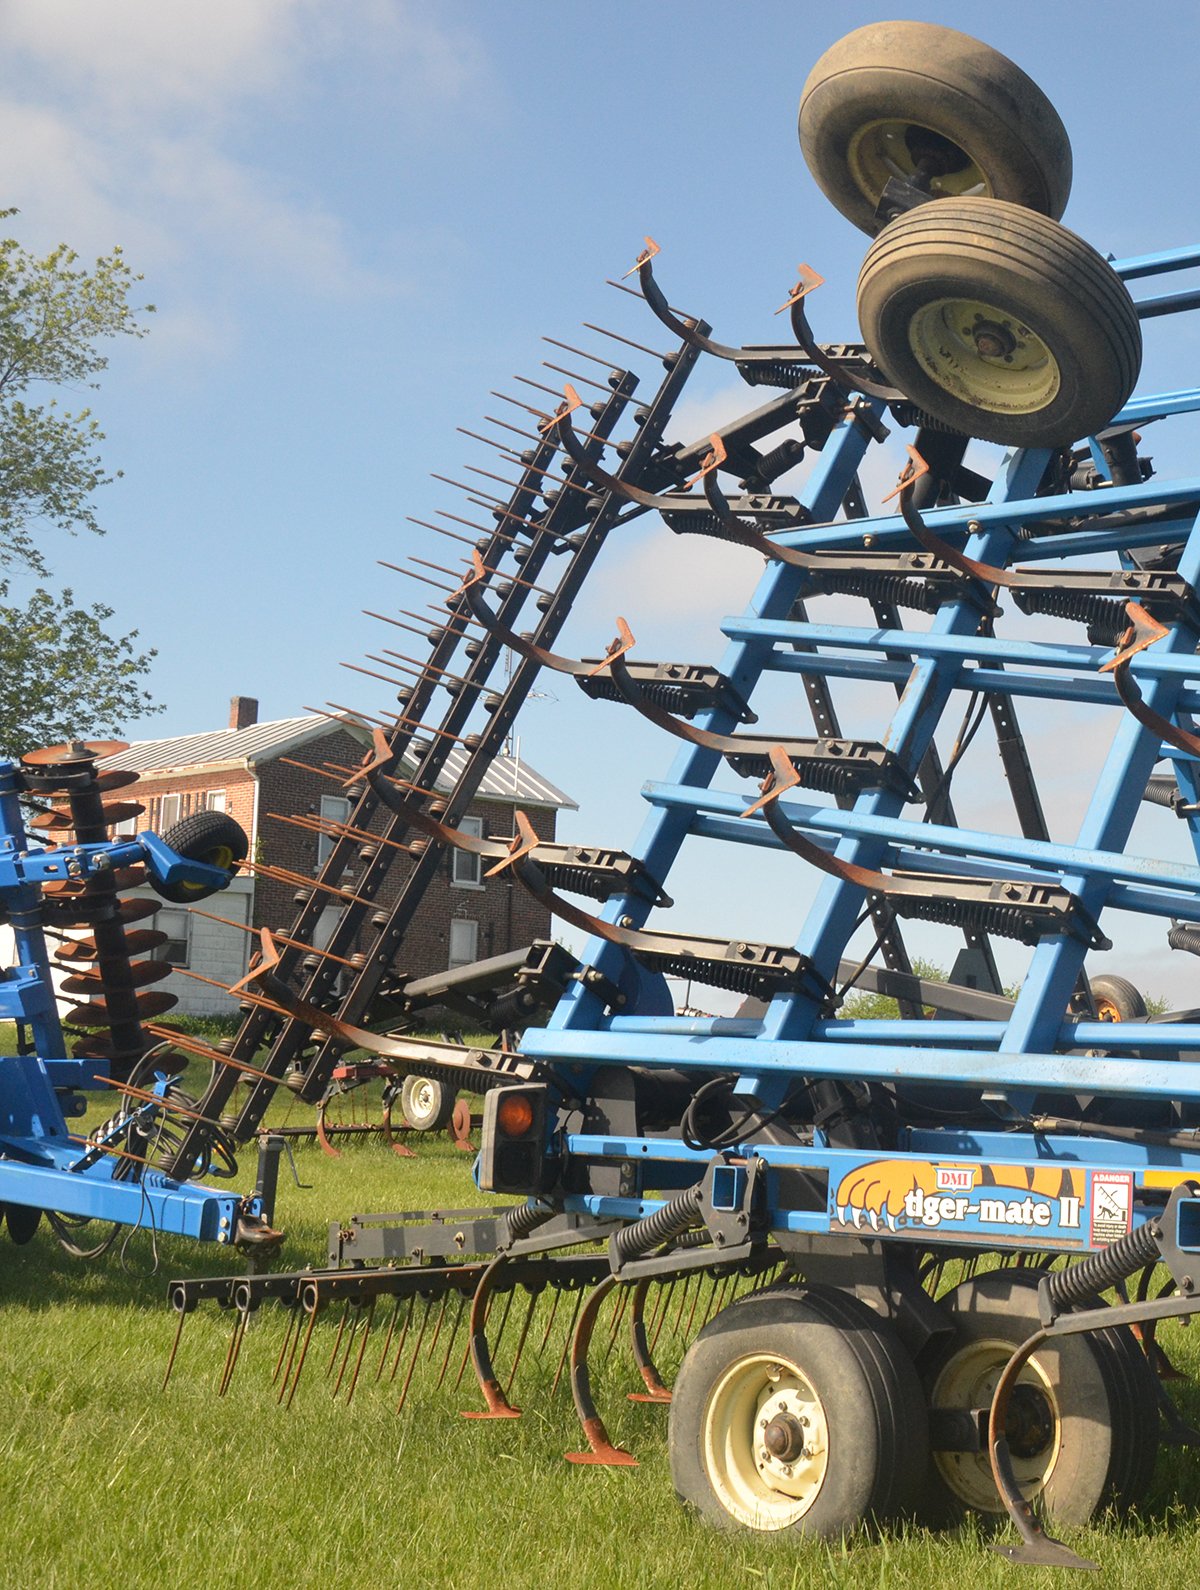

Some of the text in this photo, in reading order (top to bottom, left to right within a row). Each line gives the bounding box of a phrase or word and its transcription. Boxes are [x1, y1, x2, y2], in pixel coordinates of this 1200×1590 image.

[941, 1172, 968, 1186] DMI
[1100, 1174, 1130, 1183] DANGER
[904, 1188, 1081, 1228] tiger-mate II
